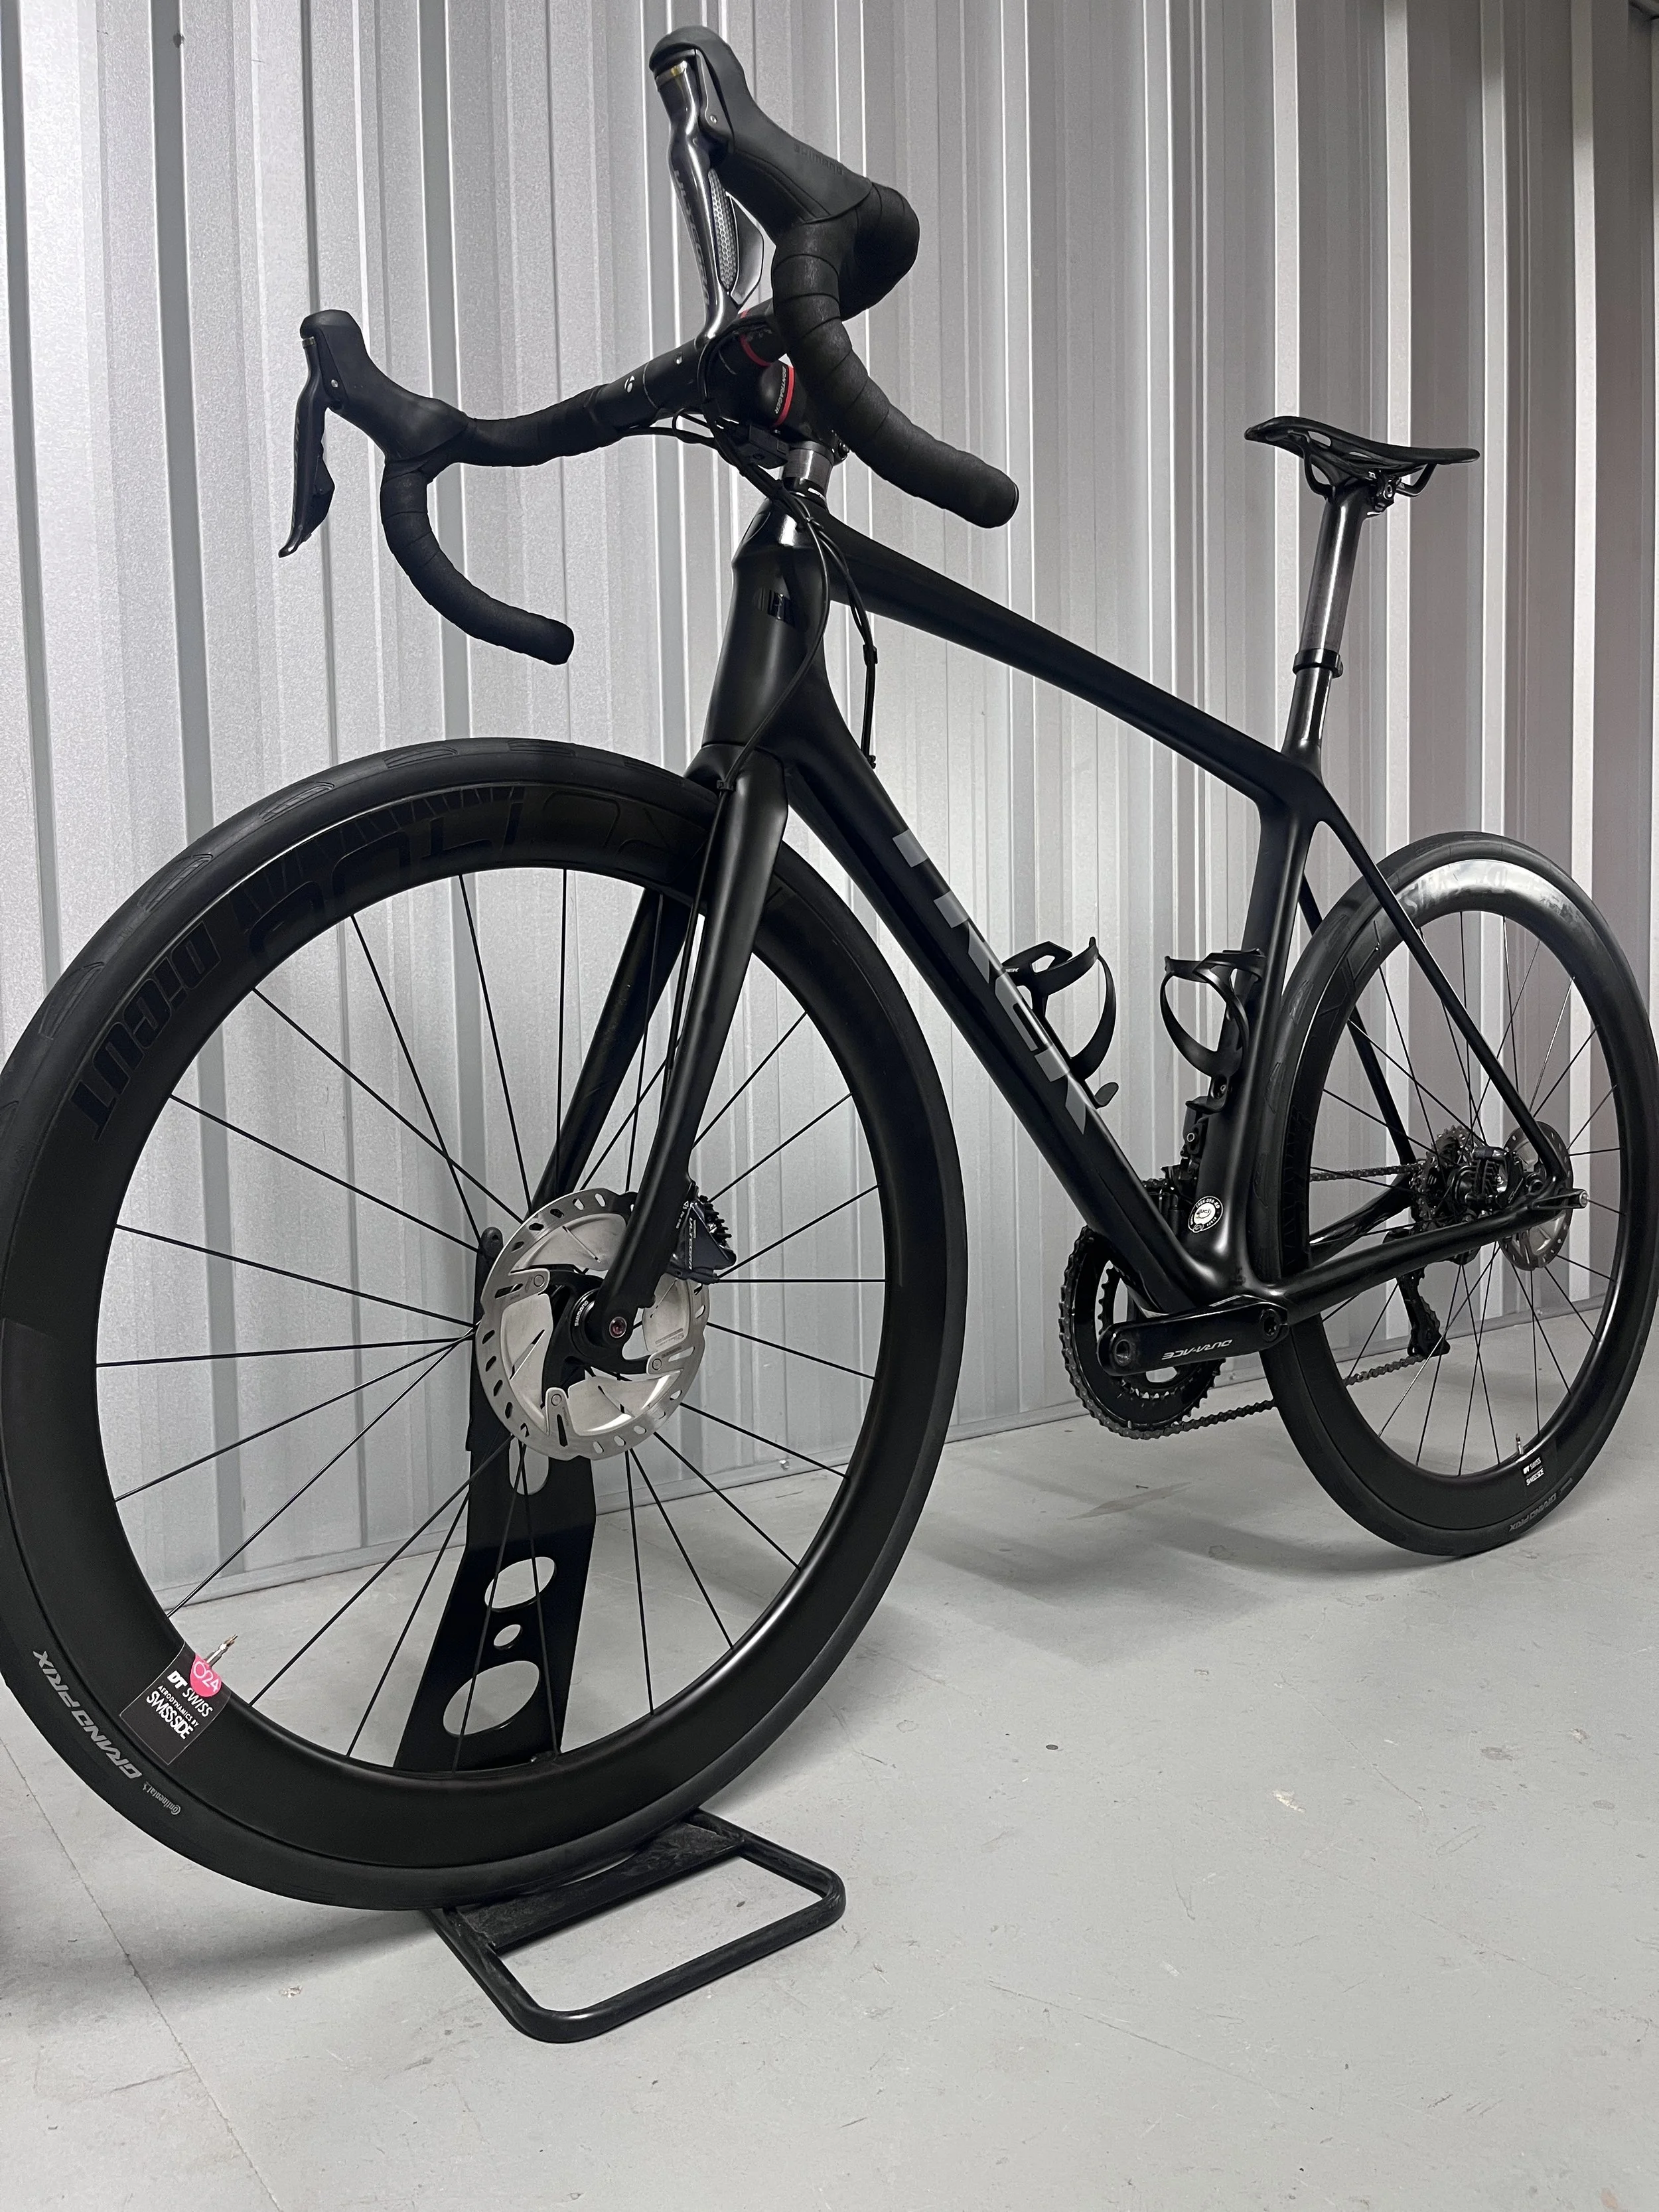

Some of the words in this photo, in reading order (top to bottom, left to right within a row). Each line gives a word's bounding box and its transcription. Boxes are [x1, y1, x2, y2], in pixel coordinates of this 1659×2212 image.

[1161, 1339, 1233, 1361] DURA-ACE
[33, 1651, 81, 1708] PRIX
[167, 1670, 188, 1689] DT
[182, 1687, 213, 1718] SWISS
[157, 1685, 193, 1722] AERODYNAMICS
[71, 1710, 143, 1779] GRAND
[146, 1783, 181, 1816] Continental
